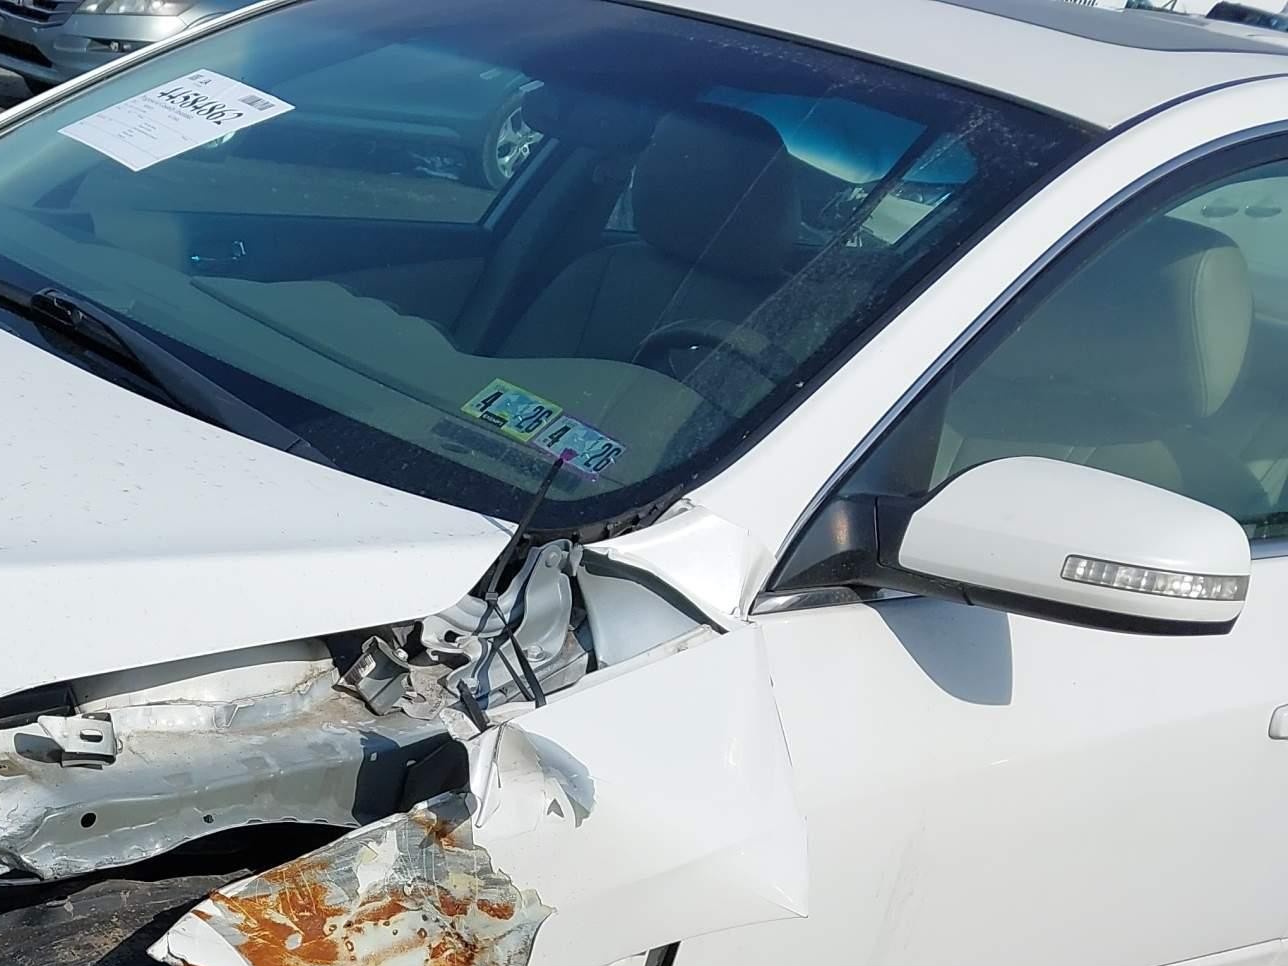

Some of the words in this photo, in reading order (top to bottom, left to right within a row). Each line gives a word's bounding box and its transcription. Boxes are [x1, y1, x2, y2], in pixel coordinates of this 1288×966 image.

[157, 87, 244, 125] 44584862
[479, 391, 504, 413] 4
[515, 405, 553, 434] 26
[547, 424, 572, 448] 4
[583, 442, 622, 472] 26
